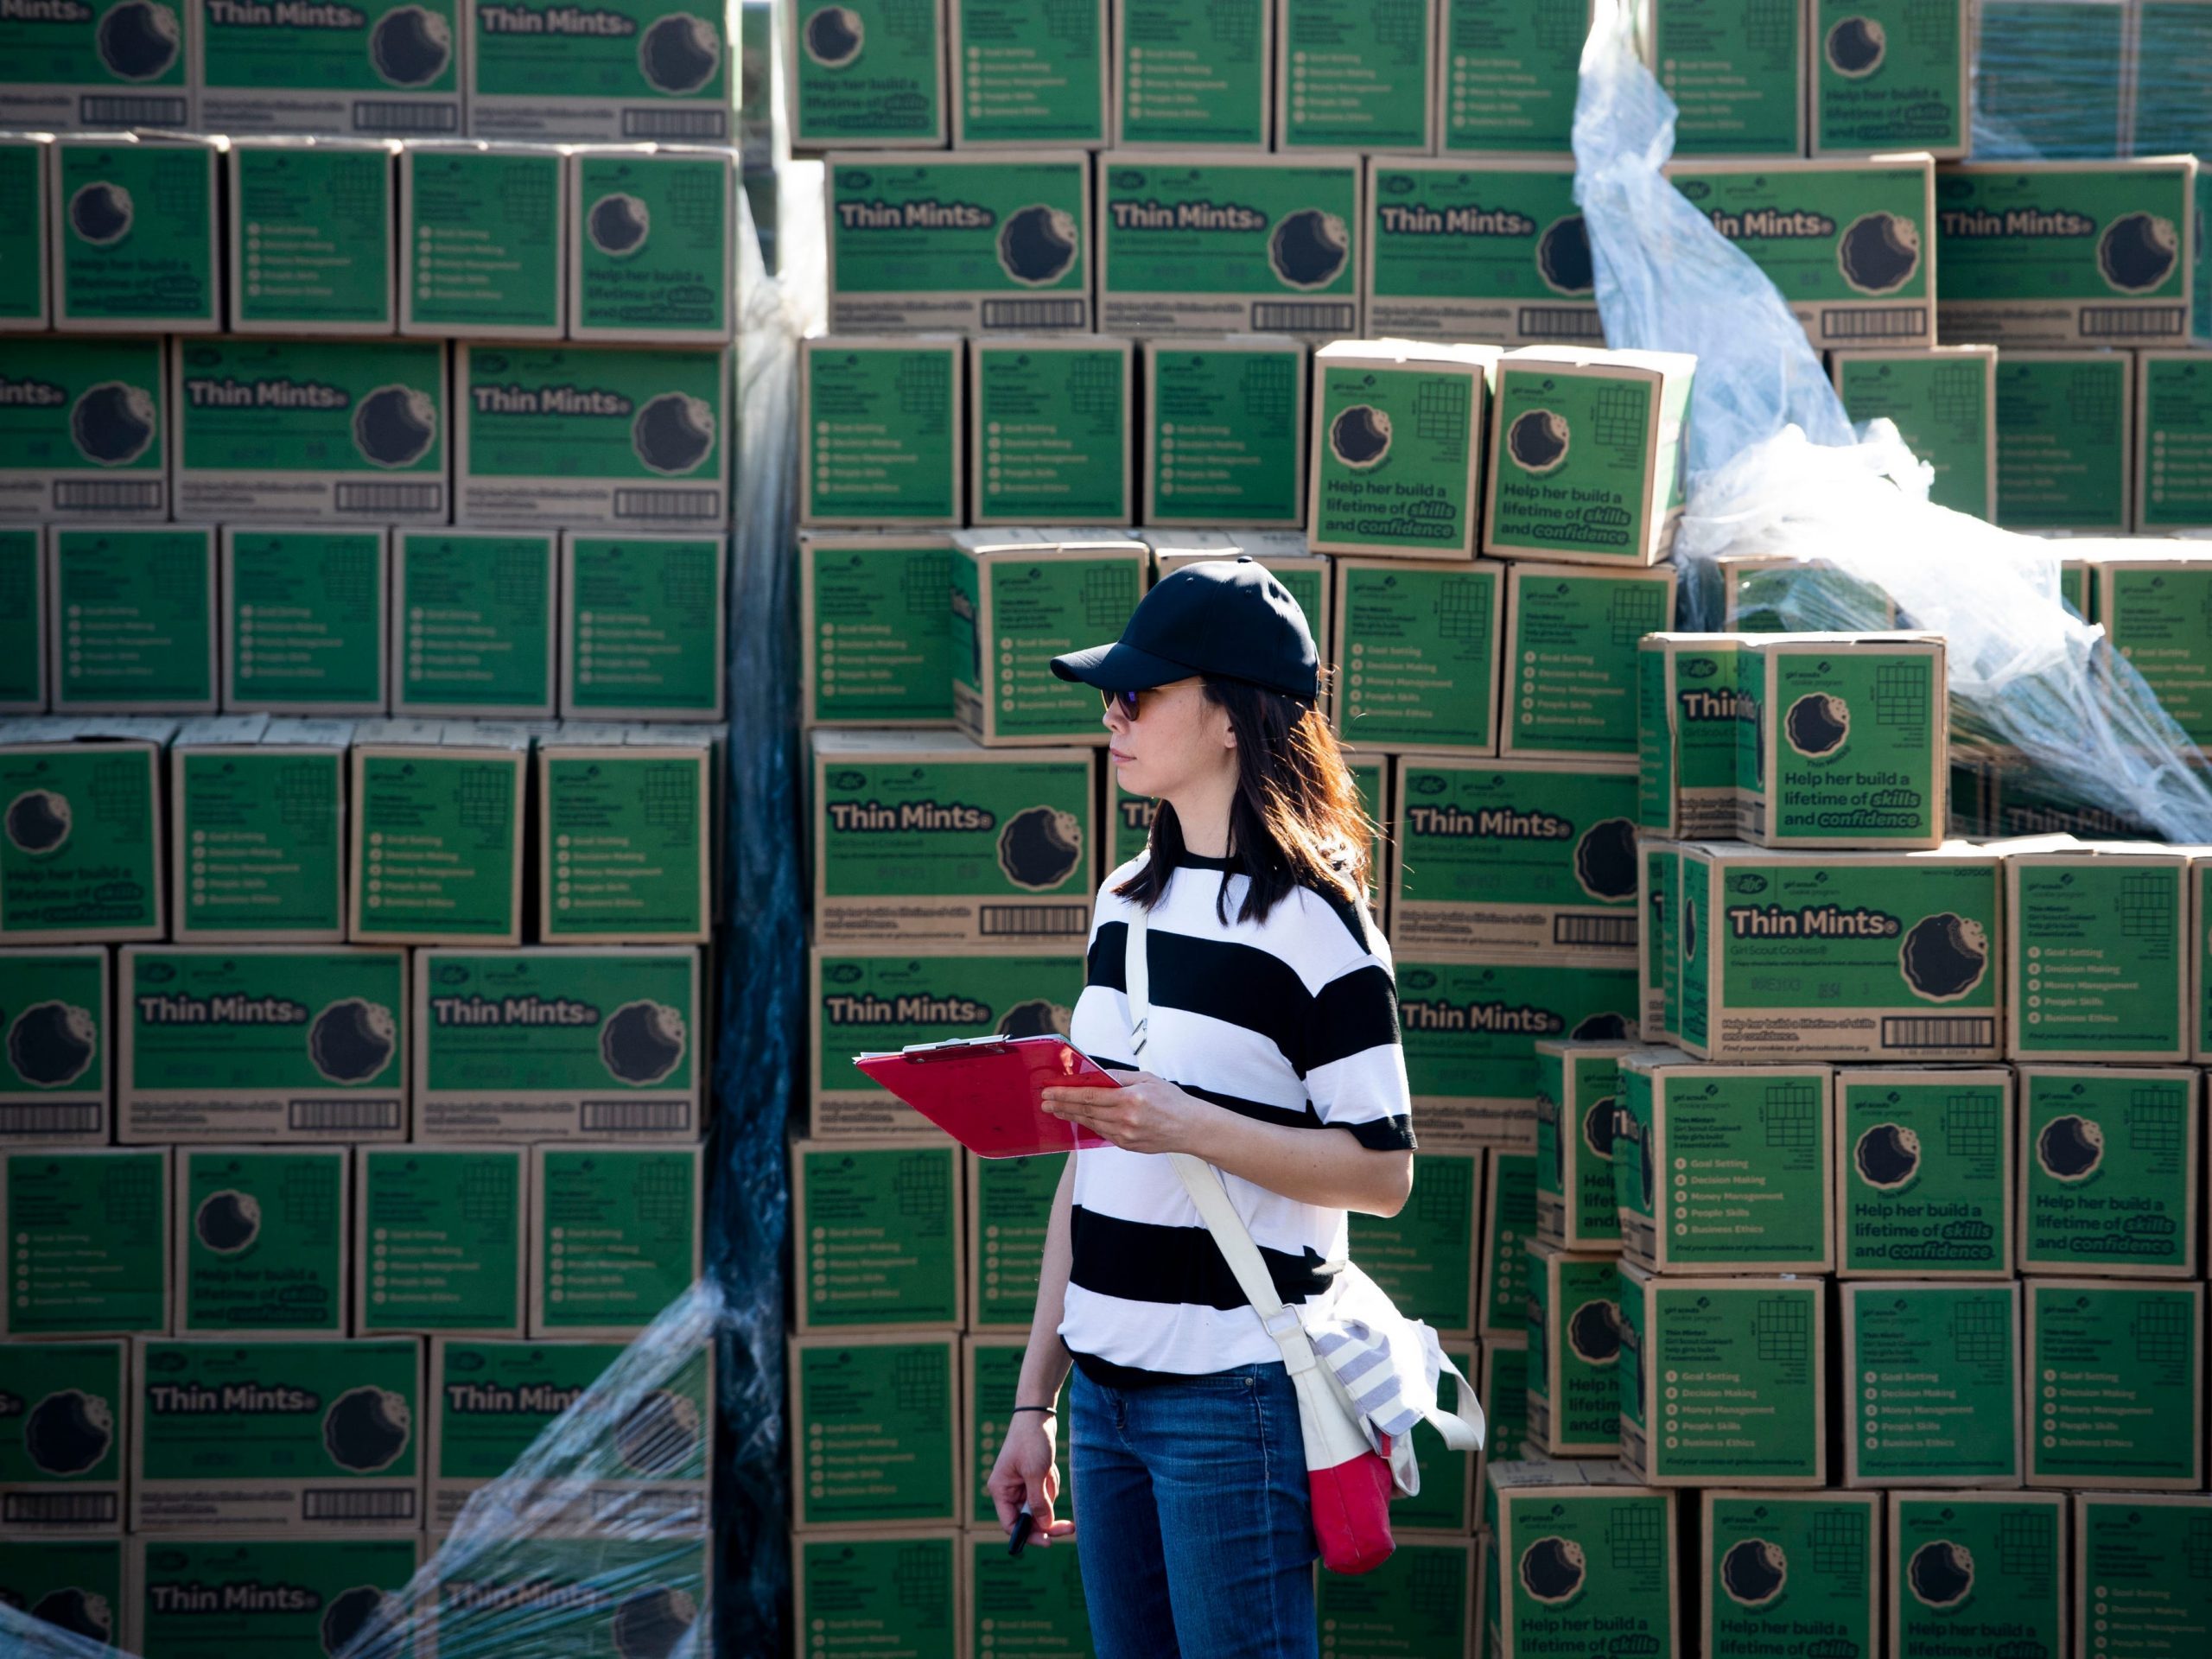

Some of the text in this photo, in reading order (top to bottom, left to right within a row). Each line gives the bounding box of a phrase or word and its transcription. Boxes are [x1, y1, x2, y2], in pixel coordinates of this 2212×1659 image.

[207, 0, 270, 26] Thin
[480, 7, 542, 34] Thin
[838, 203, 900, 227] Thin
[1112, 203, 1173, 228] Thin
[1381, 207, 1442, 232] Thin
[1940, 212, 2002, 235] Thin
[188, 381, 251, 407] Thin
[473, 387, 537, 413] Thin
[1327, 479, 1446, 498] Help her build a
[1503, 482, 1622, 505] Help her build a
[1326, 498, 1456, 519] lifetime of skills
[1502, 501, 1630, 525] lifetime of skills
[1326, 517, 1354, 531] and
[1500, 520, 1529, 536] and
[1784, 772, 1910, 788] Help her build a
[1784, 790, 1920, 807] lifetime of skills
[830, 804, 895, 830] Thin
[1409, 809, 1474, 835] Thin
[1784, 811, 1814, 826] and
[1730, 910, 1797, 935] Thin
[1731, 945, 1747, 955] Girl
[1749, 946, 1777, 955] Scout
[138, 997, 206, 1022] Thin
[433, 999, 499, 1024] Thin
[827, 998, 892, 1022] Thin
[1401, 1003, 1465, 1029] Thin
[1690, 1159, 1713, 1168] Goal
[1714, 1159, 1748, 1169] Setting
[1690, 1175, 1731, 1185] Decision
[1732, 1175, 1765, 1185] Making
[1691, 1192, 1721, 1202] Money
[1723, 1192, 1783, 1202] Management
[2036, 1194, 2164, 1211] Help her build a
[1691, 1209, 1722, 1218] People
[1725, 1208, 1749, 1217] Skills
[1855, 1203, 1982, 1219] Help her build a
[1691, 1225, 1732, 1234] Business
[1733, 1224, 1764, 1233] Ethics
[1855, 1222, 1993, 1239] lifetime of skills
[2036, 1214, 2175, 1234] lifetime of skills
[1855, 1243, 1885, 1258] and
[2036, 1234, 2066, 1249] and
[149, 1386, 217, 1412] Thin
[448, 1386, 513, 1411] Thin
[149, 1586, 218, 1611] Thin
[1521, 1616, 1649, 1634] Help her build a
[1522, 1634, 1659, 1653] lifetime of skills
